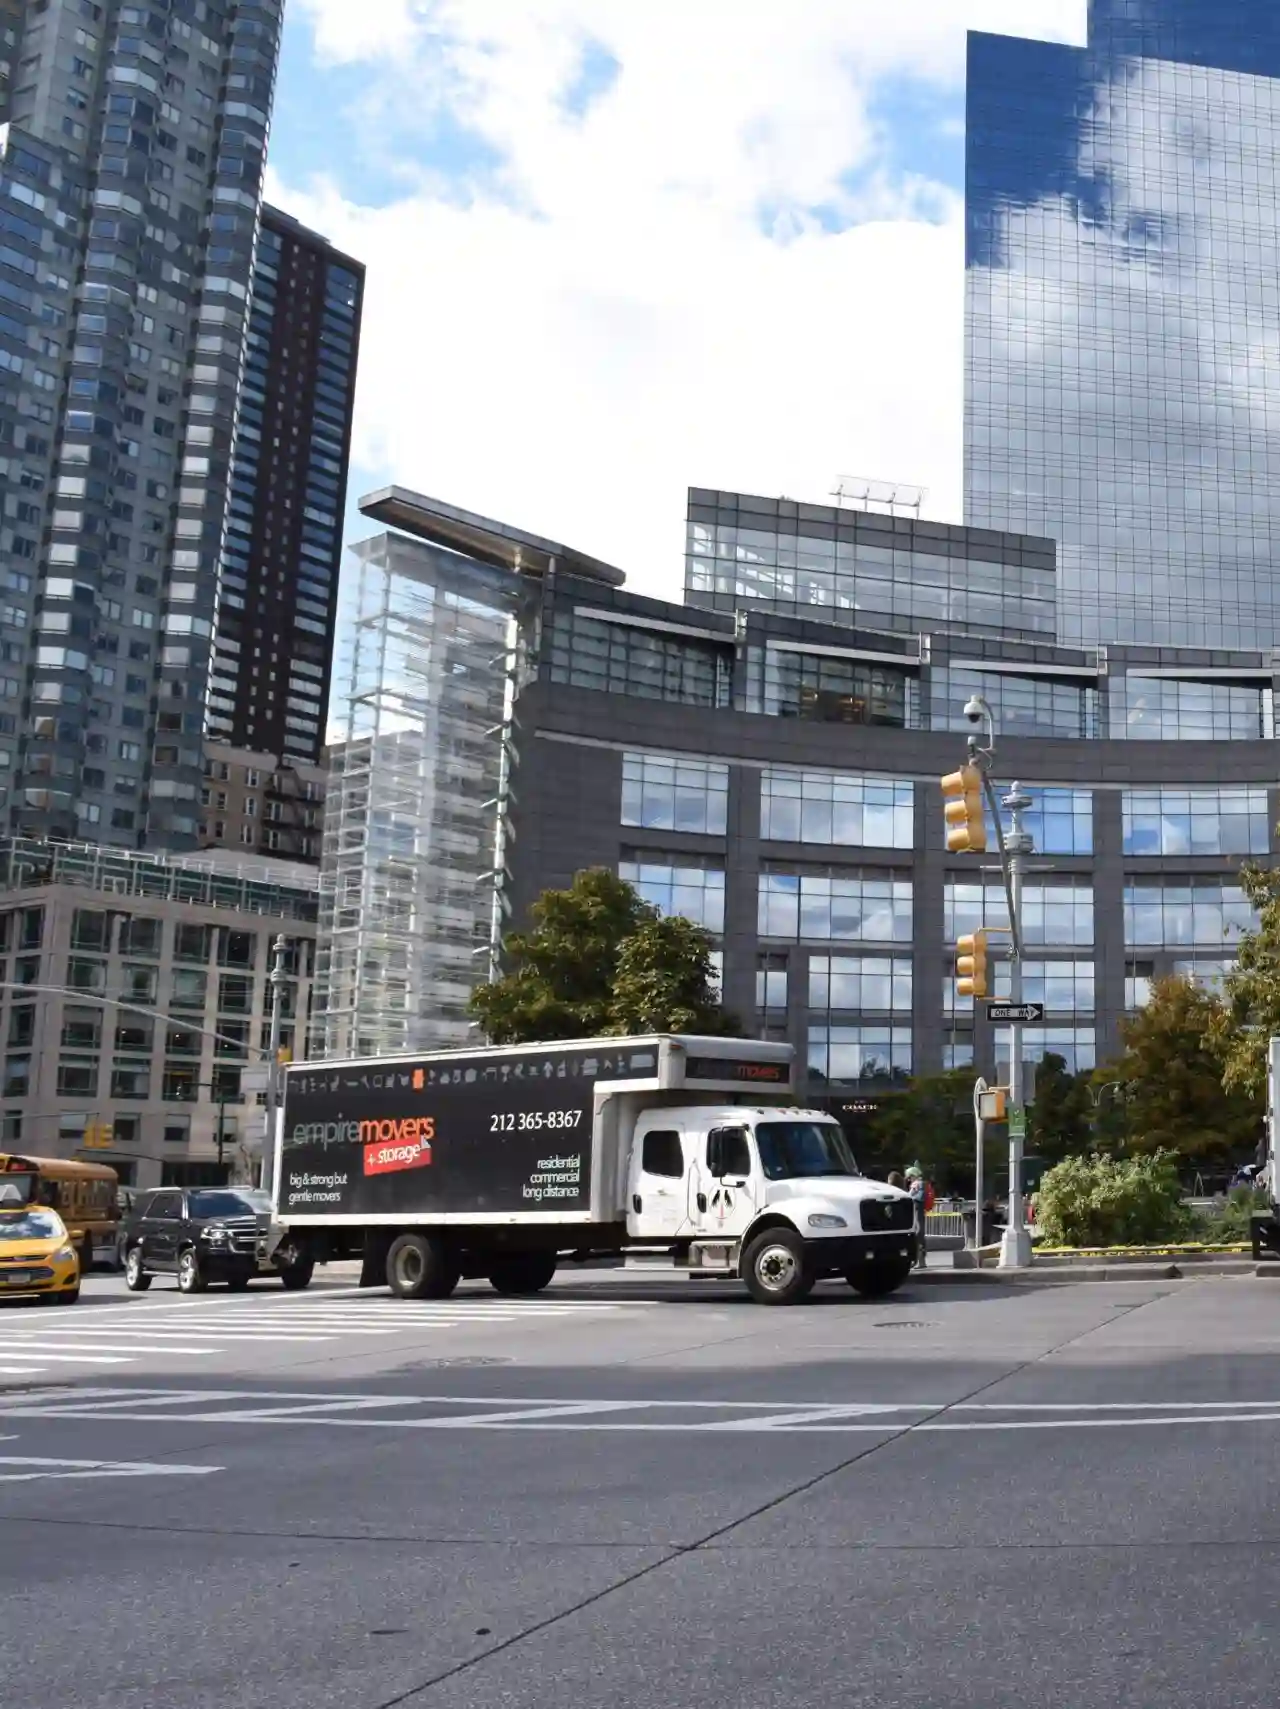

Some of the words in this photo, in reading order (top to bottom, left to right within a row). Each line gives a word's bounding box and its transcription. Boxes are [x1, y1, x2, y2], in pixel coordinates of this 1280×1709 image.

[994, 1008, 1011, 1017] ONE
[1018, 1008, 1035, 1017] WAY
[490, 1113, 515, 1132] 212
[518, 1109, 582, 1130] 365-8367
[378, 1143, 421, 1164] storage
[537, 1152, 580, 1169] residential
[290, 1173, 302, 1188] big
[302, 1173, 310, 1185] &
[310, 1174, 334, 1188] strong
[334, 1172, 348, 1185] but
[530, 1168, 580, 1184] commercial
[288, 1189, 312, 1205] gentle
[313, 1191, 341, 1202] movers
[523, 1184, 542, 1201] long
[543, 1183, 580, 1197] distance
